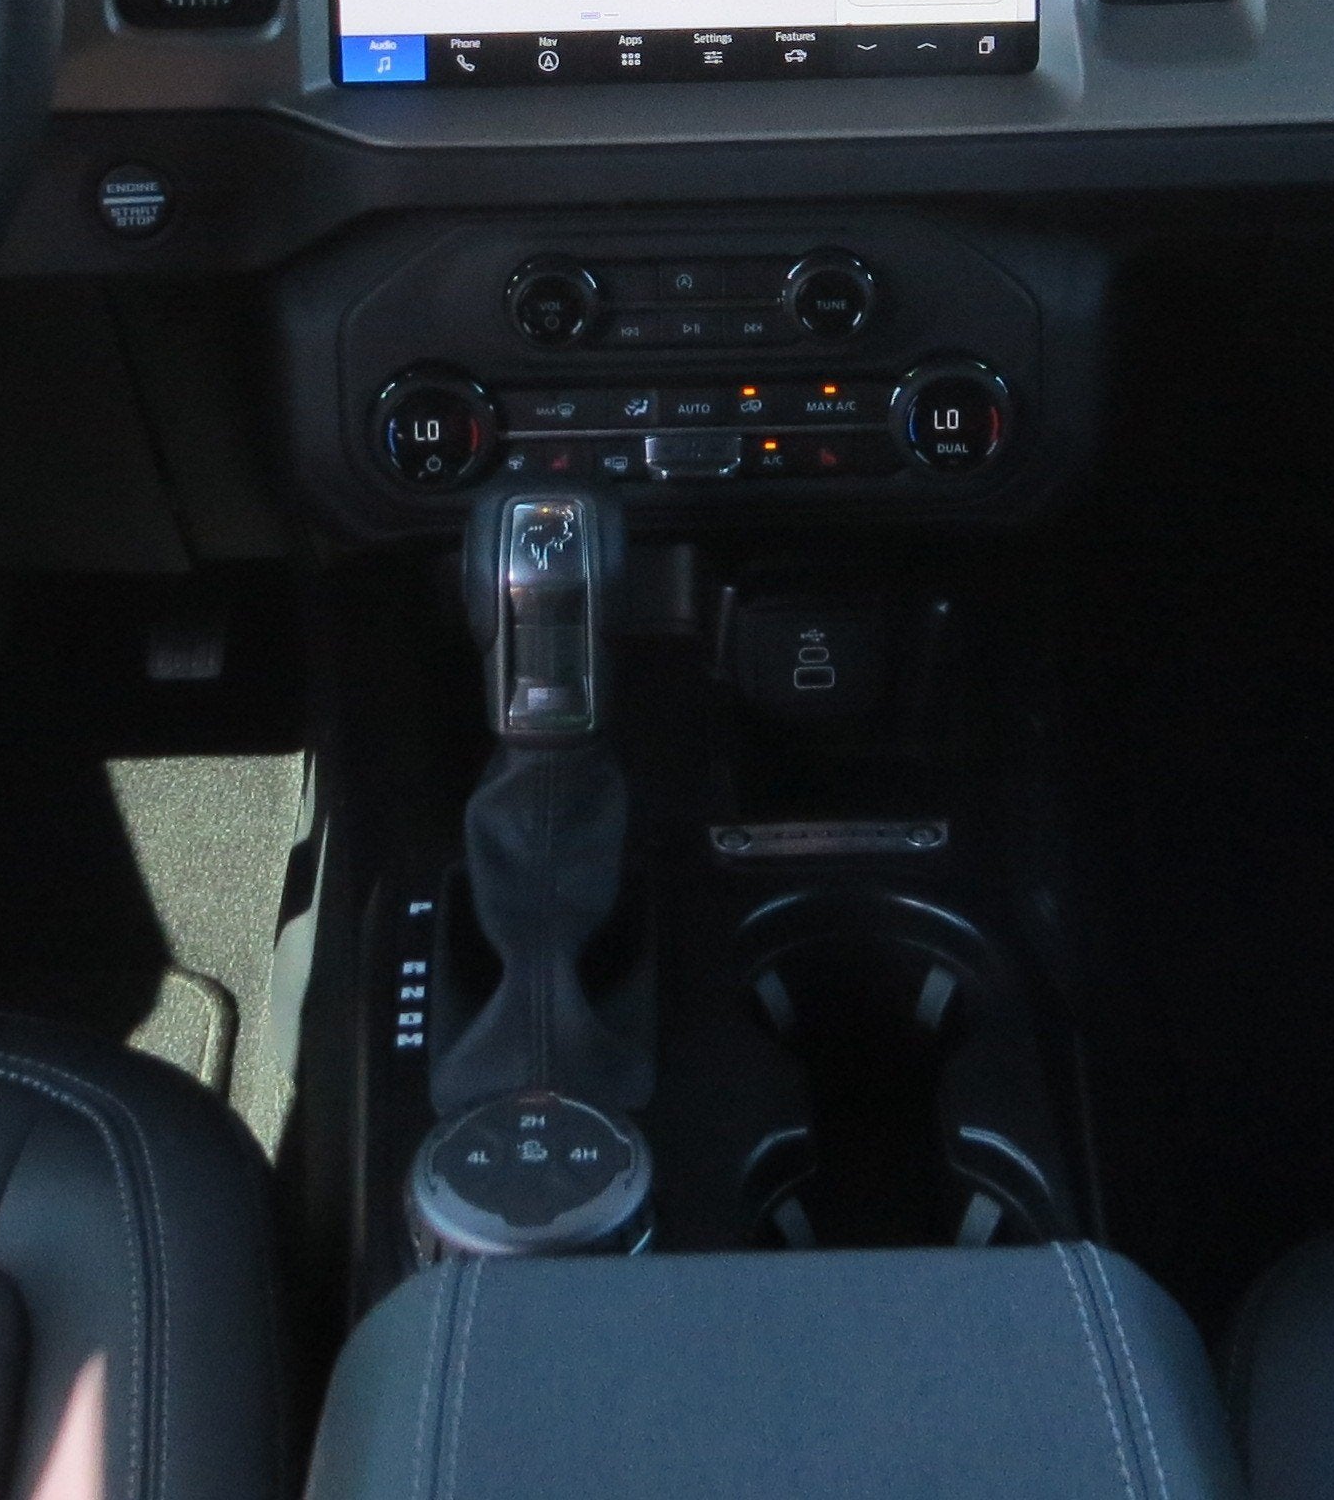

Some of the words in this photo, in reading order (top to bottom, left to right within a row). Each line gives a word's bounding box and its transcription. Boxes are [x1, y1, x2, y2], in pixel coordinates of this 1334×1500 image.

[538, 37, 558, 48] Nav
[618, 34, 643, 47] Apps
[693, 32, 733, 45] Settings
[775, 31, 816, 42] Features
[369, 39, 397, 51] Audio
[450, 38, 481, 50] Phone
[107, 181, 158, 194] ENGINE
[110, 205, 159, 218] START
[539, 301, 561, 312] VOL
[816, 300, 847, 311] TUNE
[677, 403, 711, 415] AUTO
[806, 401, 832, 412] MAX
[835, 400, 857, 412] A/C
[933, 409, 960, 430] LO
[414, 419, 440, 442] LO
[936, 442, 969, 454] DUAL
[762, 454, 784, 466] A/C
[408, 901, 433, 915] P
[400, 985, 426, 1000] N
[396, 1032, 424, 1047] M
[519, 1114, 546, 1129] 2H
[466, 1150, 491, 1164] 4L
[569, 1147, 599, 1162] 4H
